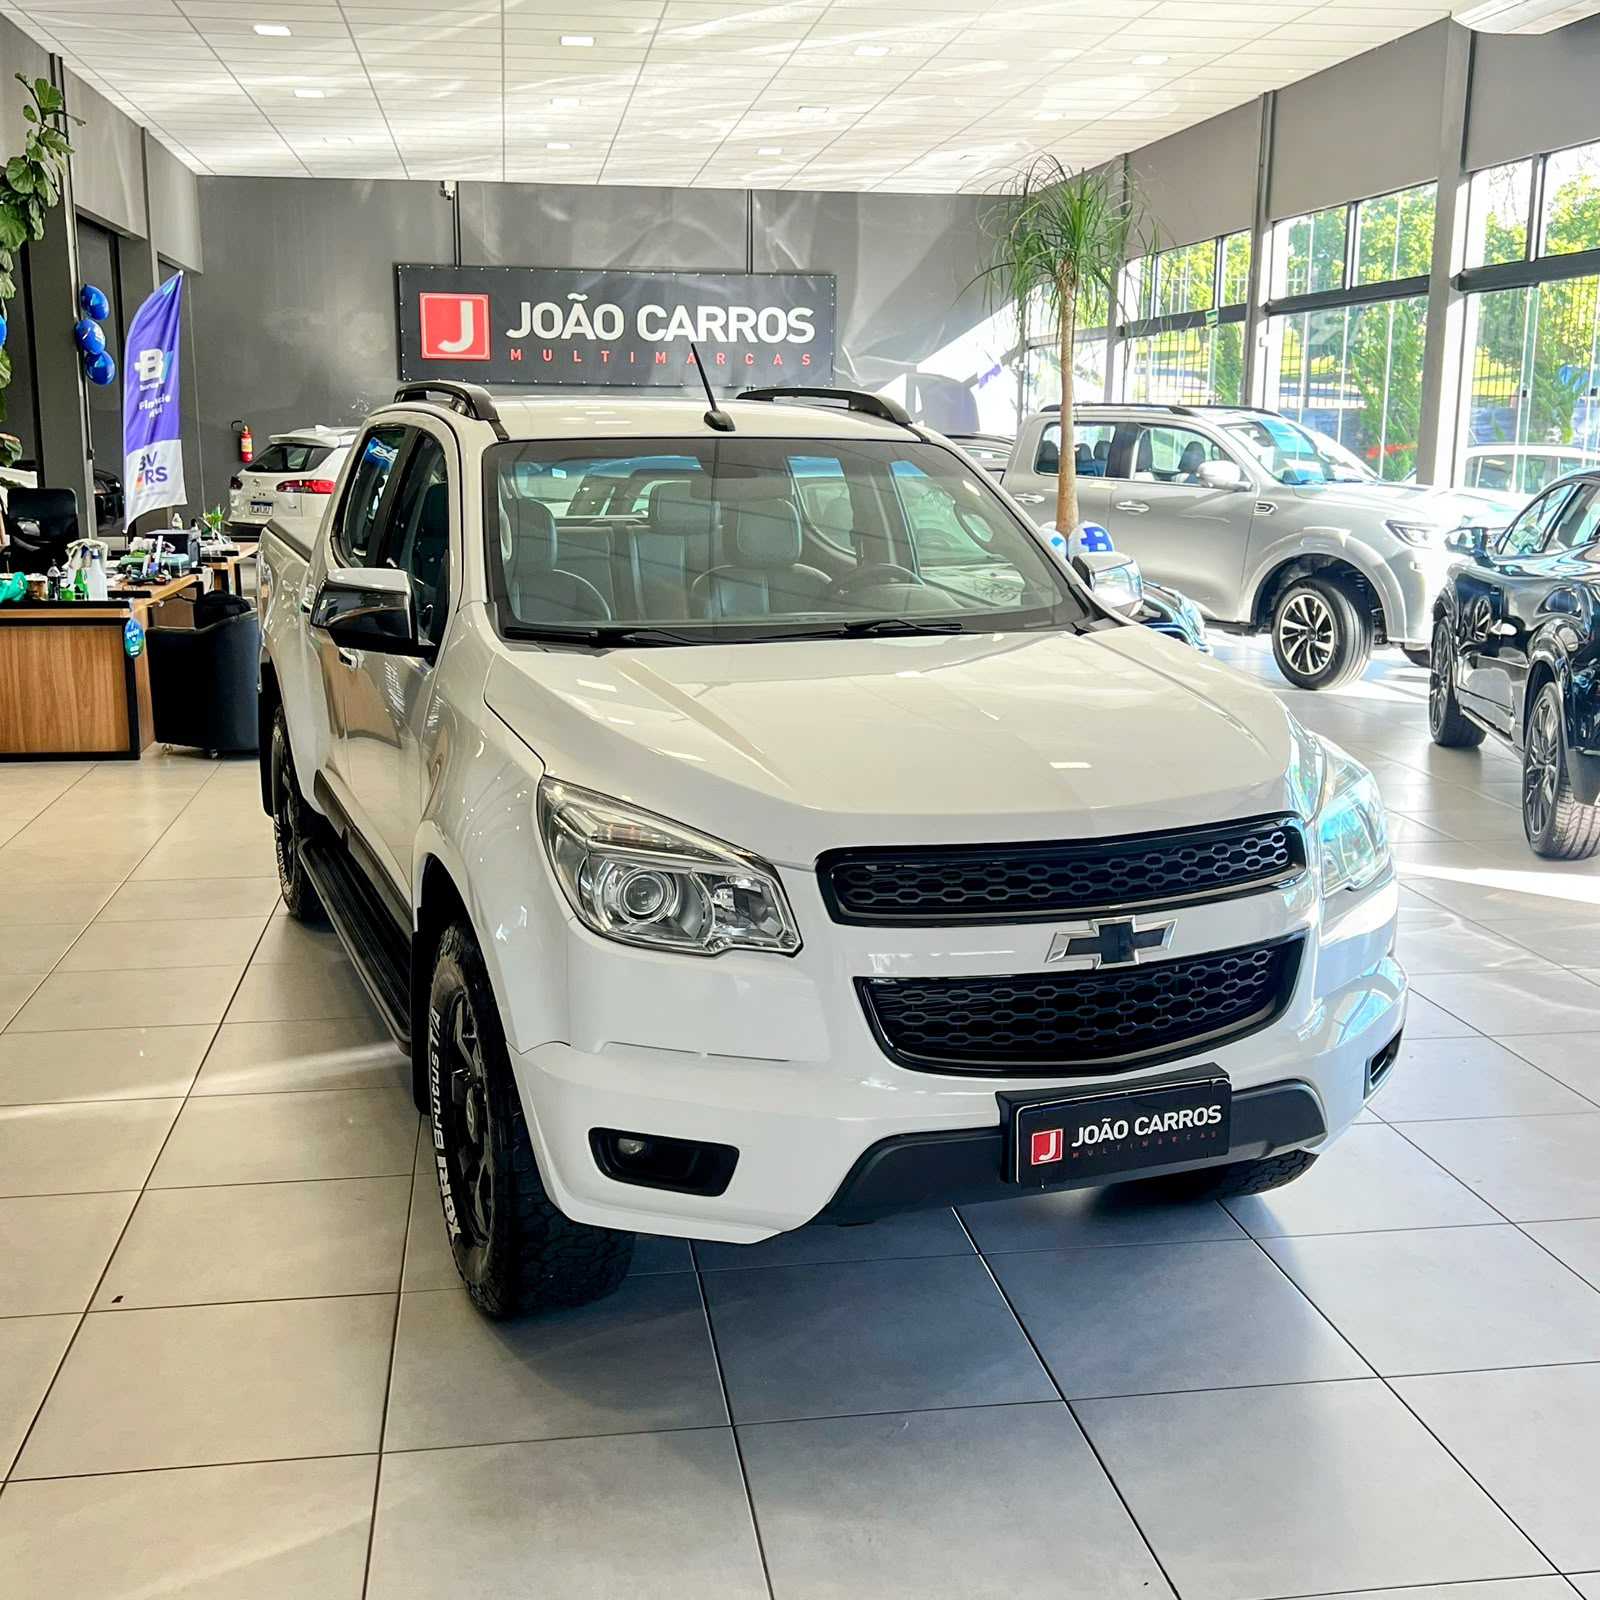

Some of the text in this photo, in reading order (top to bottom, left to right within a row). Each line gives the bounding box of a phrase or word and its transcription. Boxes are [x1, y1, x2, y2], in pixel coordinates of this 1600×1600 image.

[438, 300, 473, 353] J
[505, 292, 816, 344] JOÃO CARROS
[510, 348, 812, 366] MULTIMARCAS
[1039, 1131, 1057, 1161] J
[1072, 1105, 1222, 1147] JOÃO CARROS
